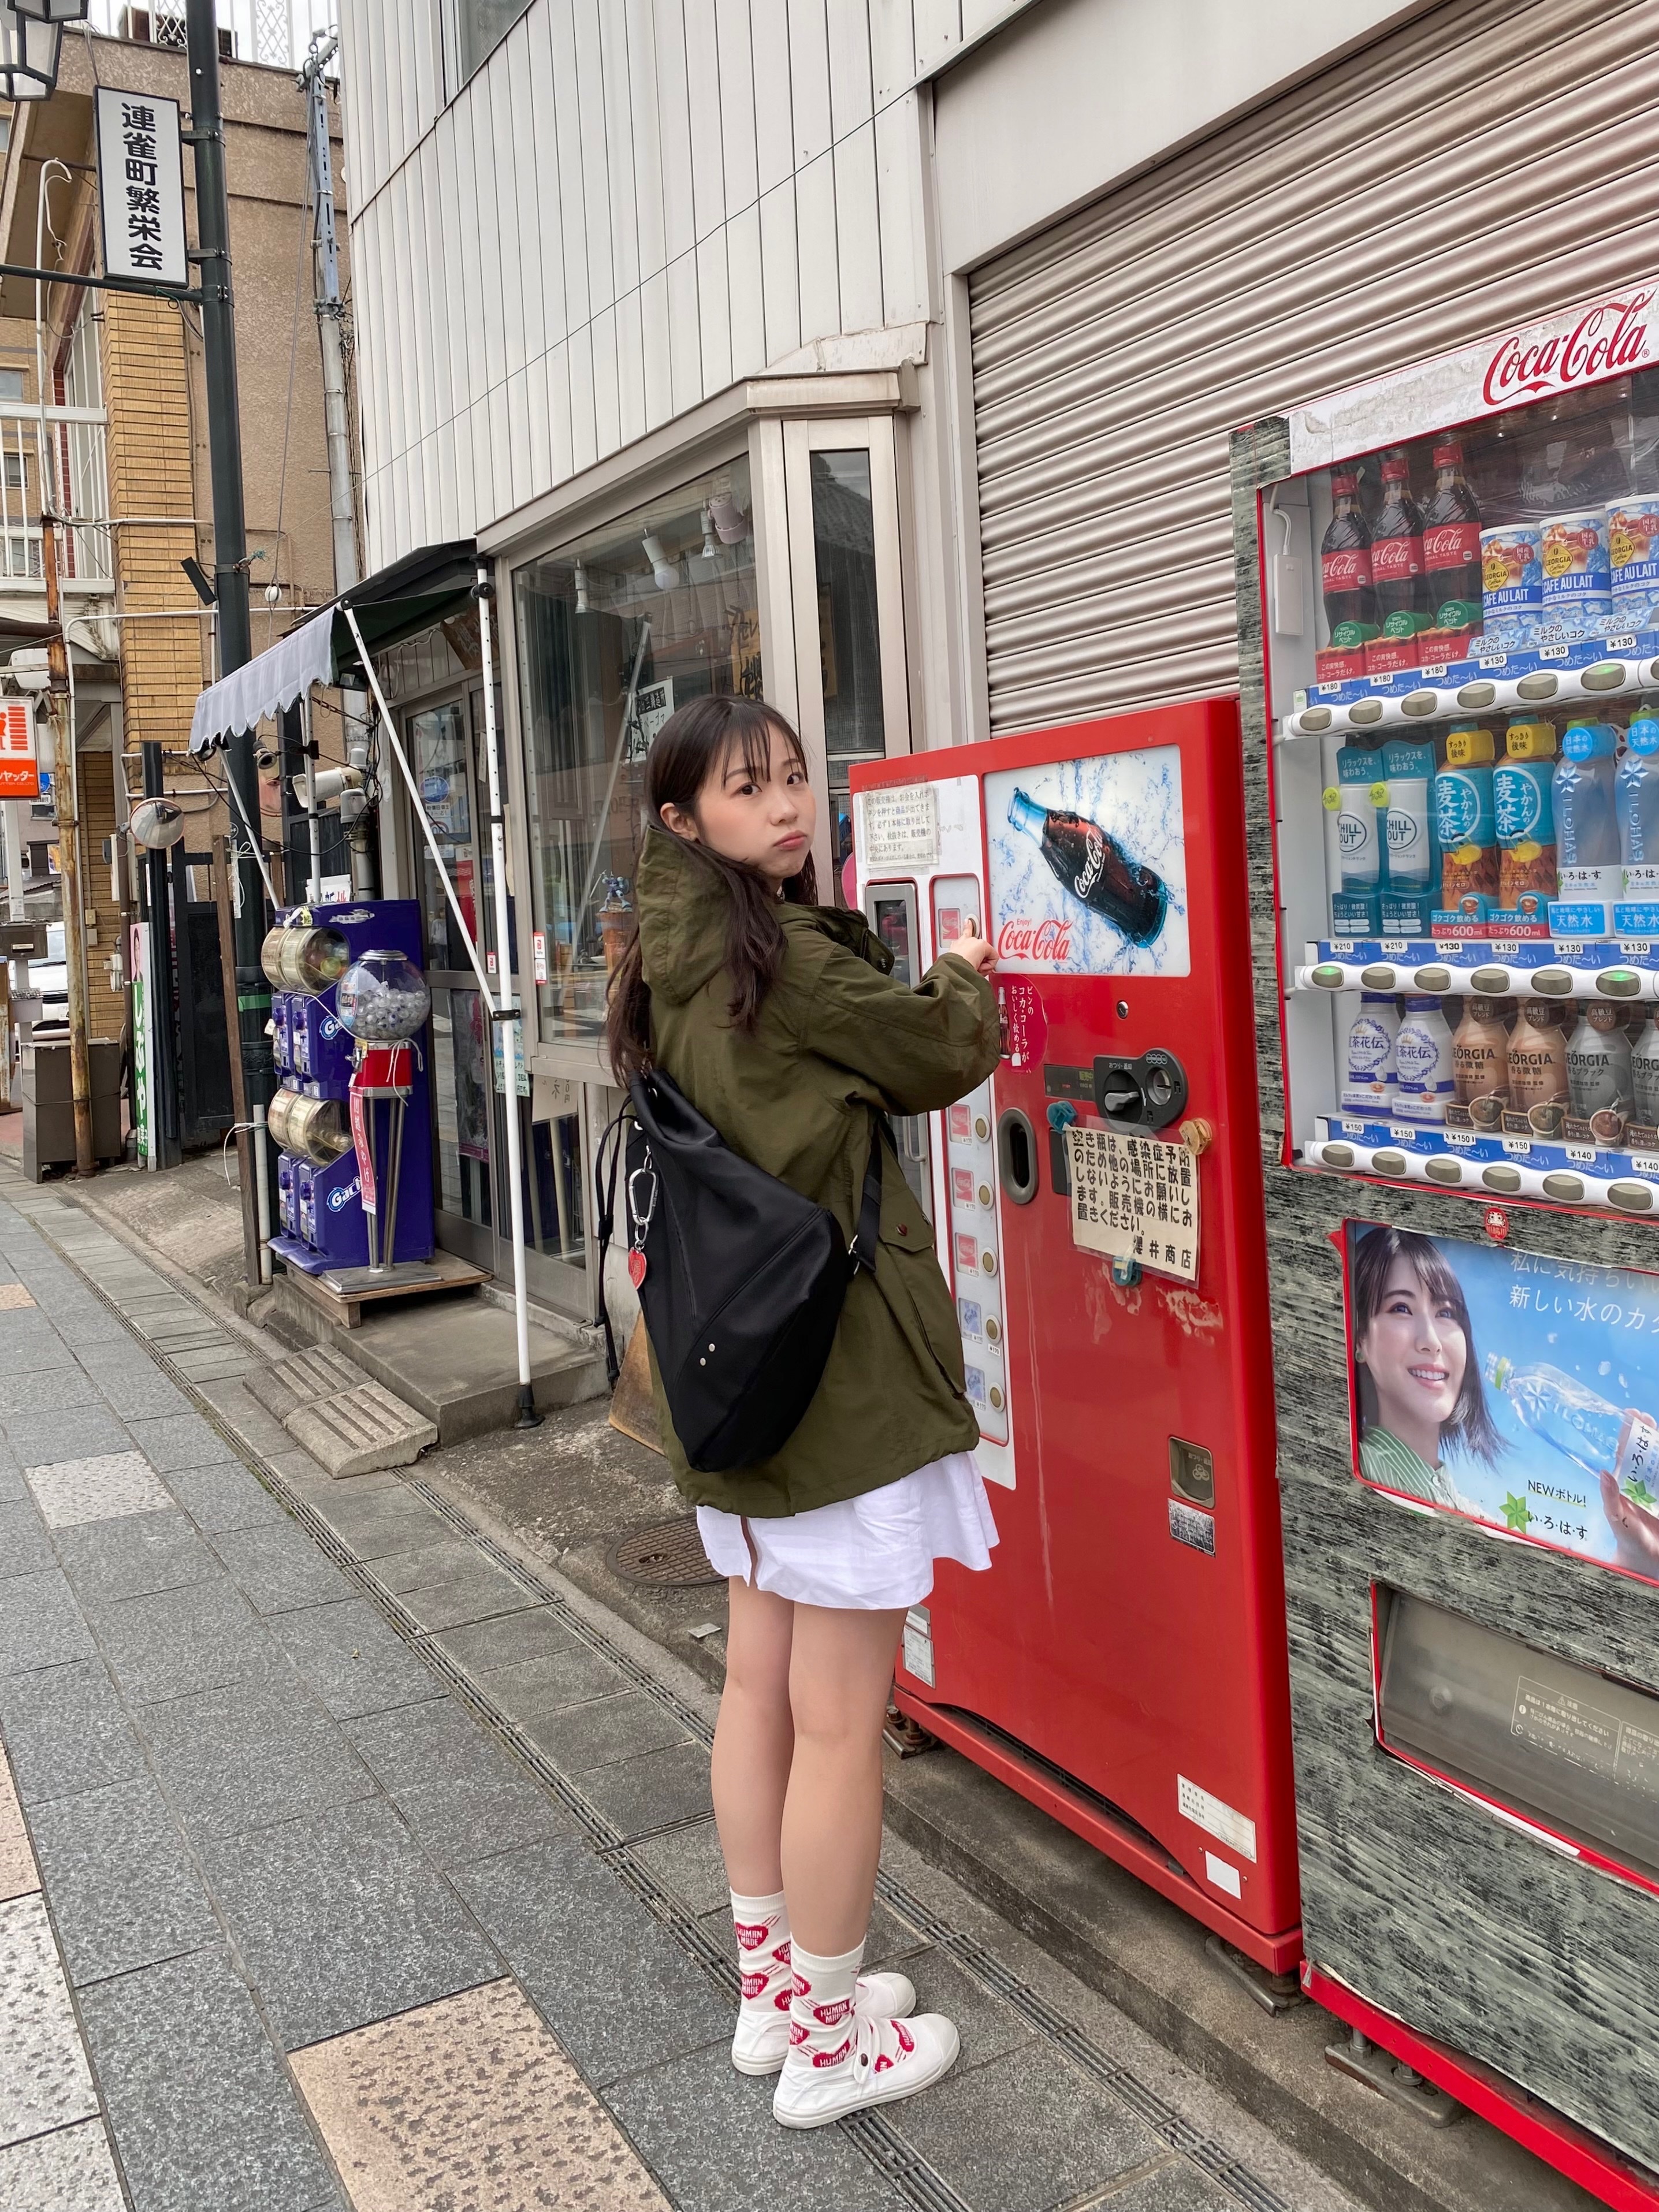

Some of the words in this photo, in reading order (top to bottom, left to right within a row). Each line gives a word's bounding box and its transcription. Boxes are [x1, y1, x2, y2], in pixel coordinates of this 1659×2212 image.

[121, 102, 163, 270] 連雀町繁栄会
[1483, 288, 1658, 405] Coca-Cola
[1624, 566, 1635, 579] AU
[1637, 563, 1657, 576] LAIT
[1561, 577, 1572, 590] AU
[1574, 575, 1593, 587] LAIT
[1498, 590, 1508, 603] AU
[1509, 589, 1528, 602] LAIT
[1439, 610, 1461, 619] リサイクル
[1386, 620, 1408, 628] リサイクル
[1599, 616, 1626, 626] ミルクの
[1604, 620, 1642, 632] やさしいコク
[1334, 630, 1355, 638] リサイクル
[1534, 625, 1562, 635] ミルクの
[1541, 630, 1585, 642] やさしいコク
[1475, 636, 1499, 647] ミルクの
[1479, 640, 1516, 653] やさしいコク
[1610, 637, 1632, 648] ¥130
[1545, 646, 1565, 657] ¥130
[1484, 656, 1504, 666] ¥130
[1425, 666, 1443, 675] ¥180
[1374, 675, 1390, 683] ¥180
[1321, 683, 1338, 691] ¥180
[1632, 727, 1657, 737] 日本の
[1449, 740, 1466, 748] すっきり
[1565, 735, 1587, 744] 日本の
[1632, 736, 1658, 747] 天然水
[1512, 742, 1527, 751] 後味
[1566, 745, 1588, 754] 天然水
[1389, 751, 1426, 762] リラックスを、
[1451, 749, 1465, 758] 後味
[1342, 758, 1376, 768] リラックスを、
[1389, 762, 1418, 772] 味わおう。
[1343, 768, 1369, 777] 味わおう。
[1460, 788, 1472, 826] やかんの
[1496, 774, 1520, 833] 麦茶
[1520, 783, 1532, 822] やかんの
[1438, 780, 1460, 836] 麦茶
[1340, 835, 1356, 843] OUT
[1388, 832, 1405, 841] OUT
[1490, 913, 1537, 922] ゴクゴク飲める
[1557, 915, 1593, 927] 天然水
[1622, 914, 1659, 927] 天然水
[998, 919, 1073, 961] Coca-Cola
[1624, 944, 1647, 952] ¥130
[1472, 1004, 1490, 1012] 高級豆
[1527, 1007, 1545, 1015] 高級豆
[1591, 1008, 1613, 1016] 高級豆
[1011, 985, 1020, 1053] おいしく飲める
[1455, 1061, 1484, 1069] 香る微糖
[1511, 1066, 1542, 1075] 香る微糖
[1394, 1130, 1413, 1138] ¥150
[1452, 1134, 1470, 1143] ¥150
[1508, 1141, 1528, 1150] ¥150
[1570, 1150, 1591, 1160] ¥140
[1074, 1148, 1192, 1187] のため他の場所に放置
[1635, 1161, 1658, 1171] ¥140
[1076, 1166, 1190, 1206] しないようにお願いし
[1077, 1185, 1192, 1228] ます。販売機の横にお
[1078, 1202, 1145, 1236] 置きください。
[736, 1927, 762, 1938] HUMAN
[741, 1937, 758, 1946] MADE
[820, 2001, 848, 2018] HUMAN
